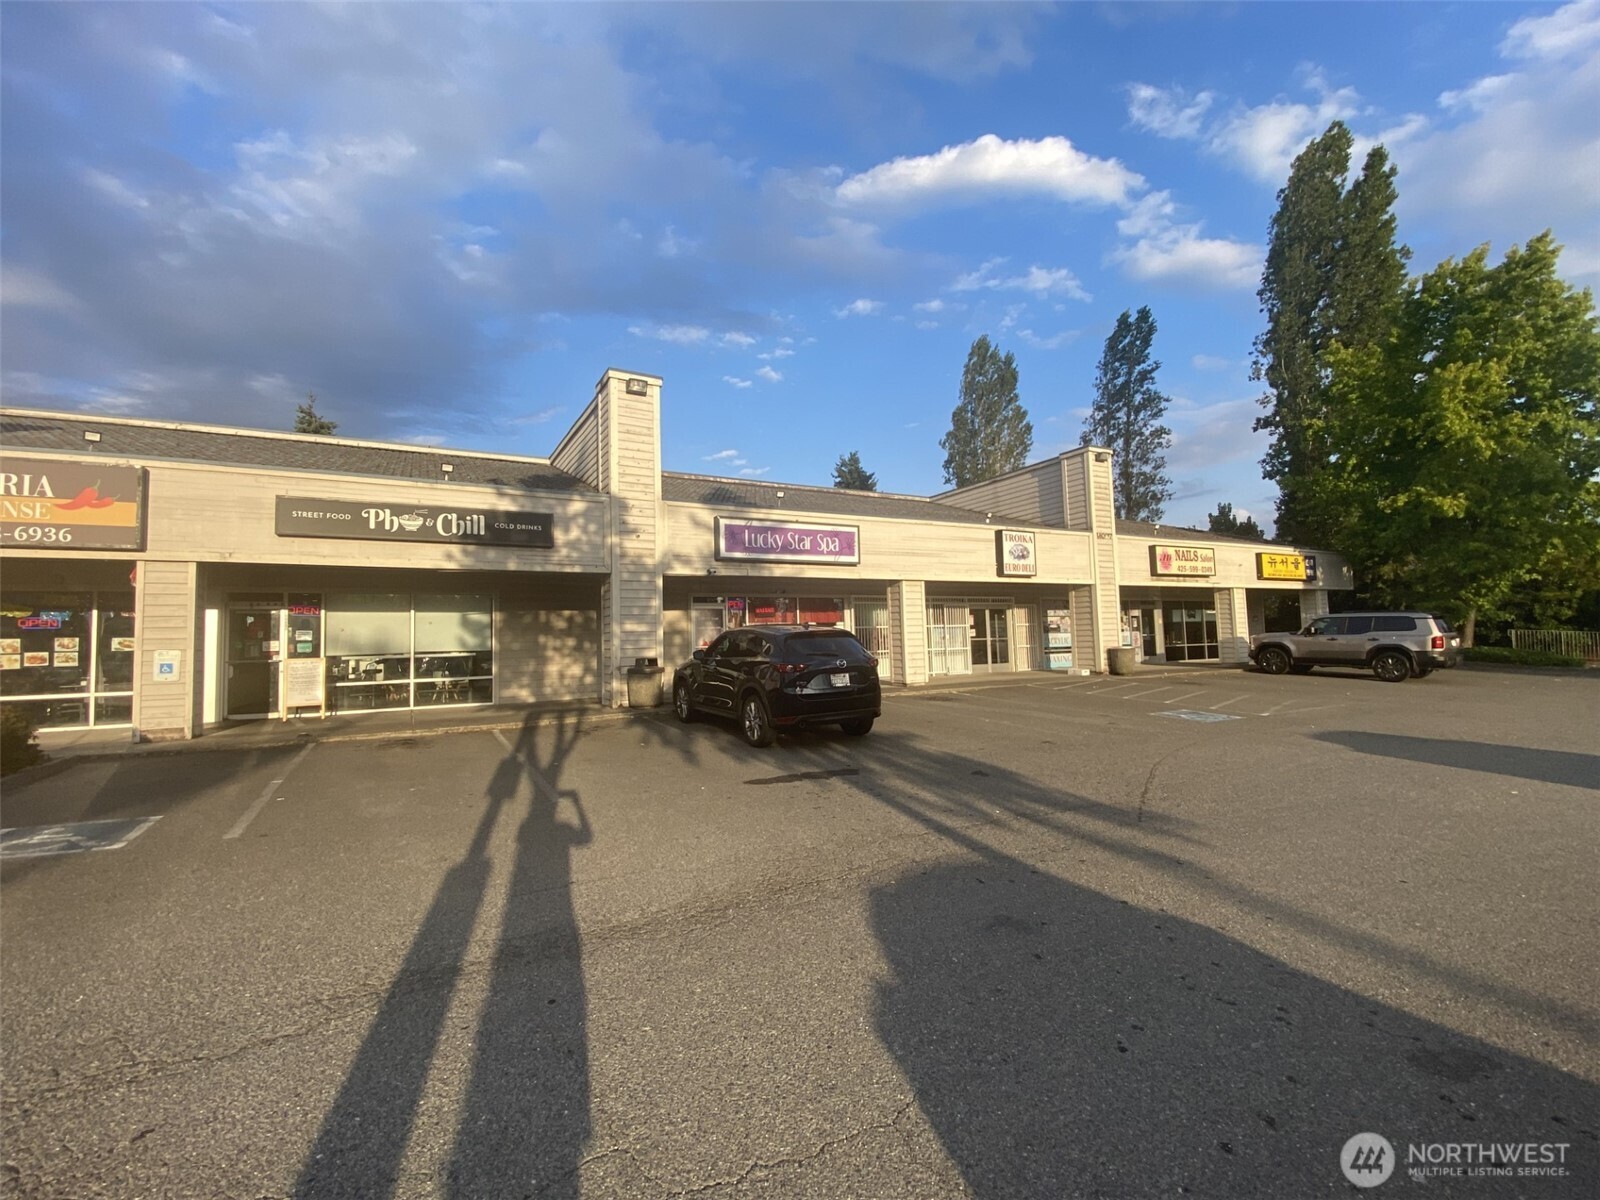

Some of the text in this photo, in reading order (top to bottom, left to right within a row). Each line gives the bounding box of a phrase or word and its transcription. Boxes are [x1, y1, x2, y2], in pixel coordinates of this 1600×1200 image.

[0, 472, 55, 498] RIA
[291, 510, 351, 520] STREET FOOD
[435, 511, 486, 536] Chill
[494, 522, 542, 531] COLD DRINKS
[0, 526, 72, 543] -6936
[1004, 533, 1033, 544] TROIKA
[744, 529, 840, 554] Lucky Star Spa
[1174, 549, 1199, 562] NAILS
[1004, 562, 1035, 573] EURO DELI
[1267, 556, 1301, 570] 뉴서울
[17, 618, 58, 627] OPEN
